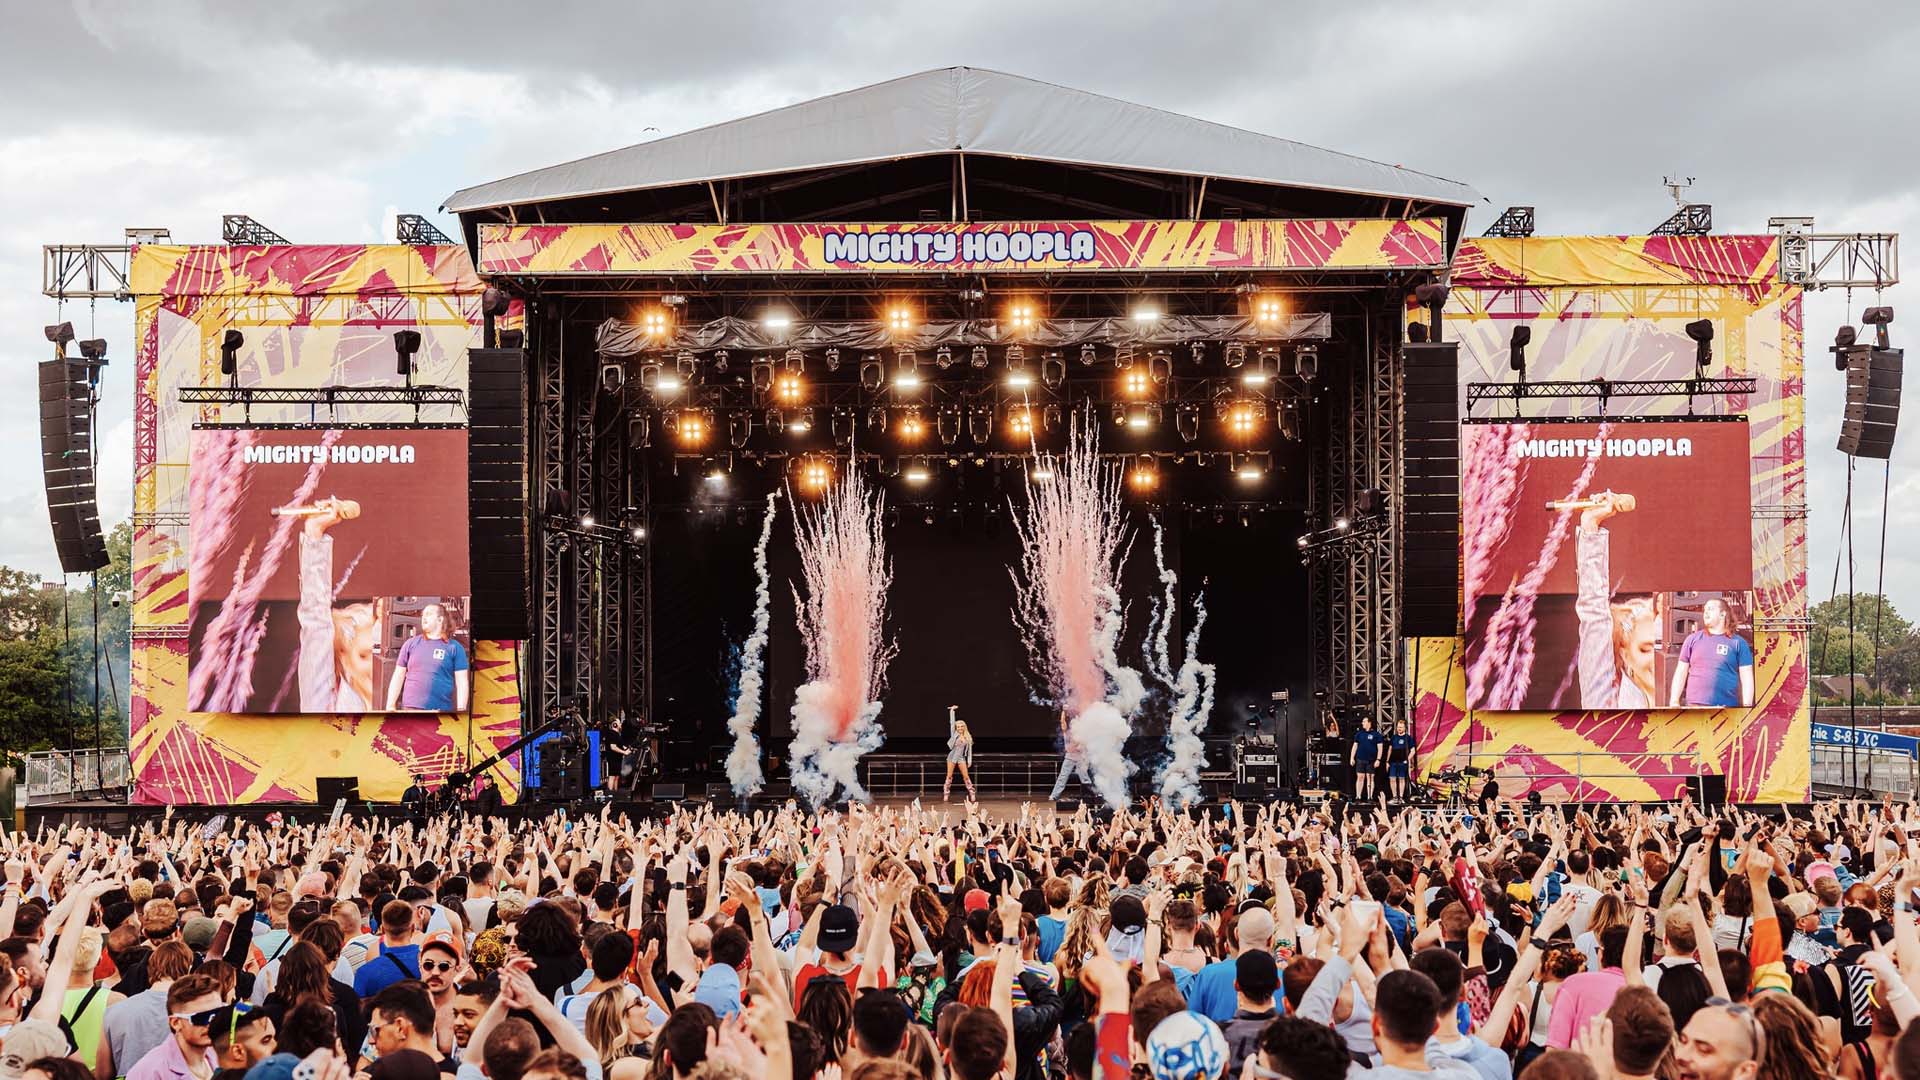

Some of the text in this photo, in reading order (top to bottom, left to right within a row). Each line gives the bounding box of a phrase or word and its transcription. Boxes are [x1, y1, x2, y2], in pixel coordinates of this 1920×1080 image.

[824, 231, 1095, 263] MIGHTY HOOPLA
[244, 445, 415, 464] MIGHTY HOOPLA
[1517, 438, 1692, 457] MIGHTY HOOPLA
[1812, 727, 1828, 740] nie
[1861, 732, 1879, 747] XC
